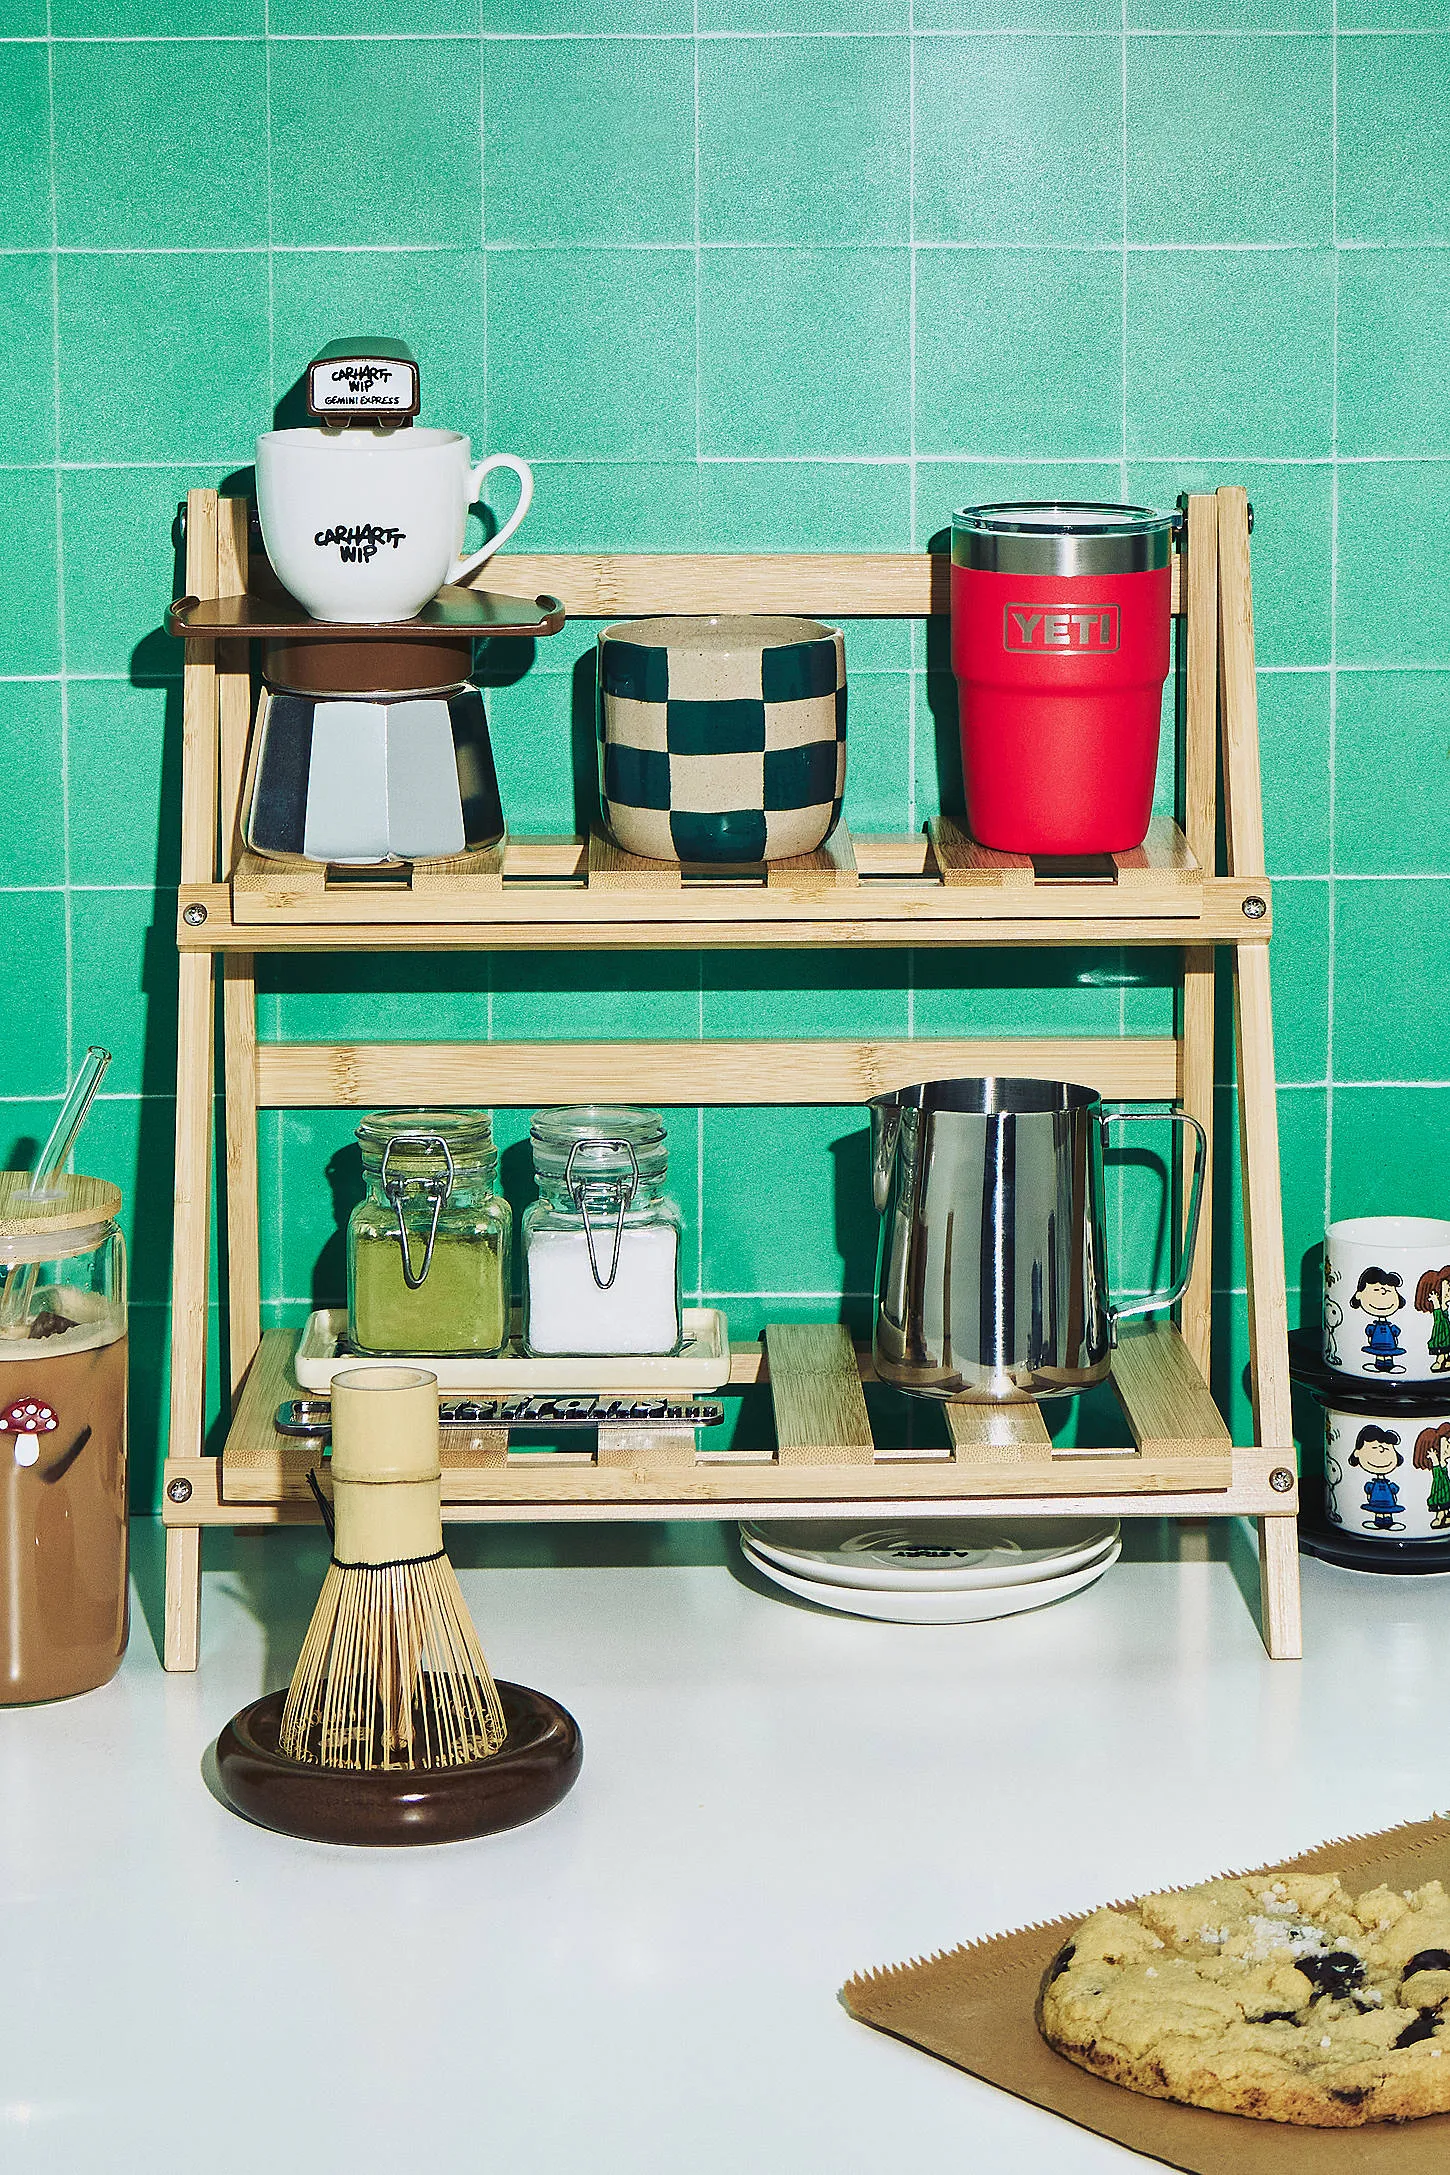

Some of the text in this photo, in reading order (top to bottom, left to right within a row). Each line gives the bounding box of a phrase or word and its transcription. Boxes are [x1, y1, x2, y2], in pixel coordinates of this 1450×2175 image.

[331, 365, 393, 383] CARHARTT
[348, 379, 375, 392] WIP
[324, 396, 400, 405] GEMINI EXPRESS
[314, 523, 407, 549] CARHARTT
[339, 544, 378, 564] WIP
[1011, 613, 1111, 645] YETI
